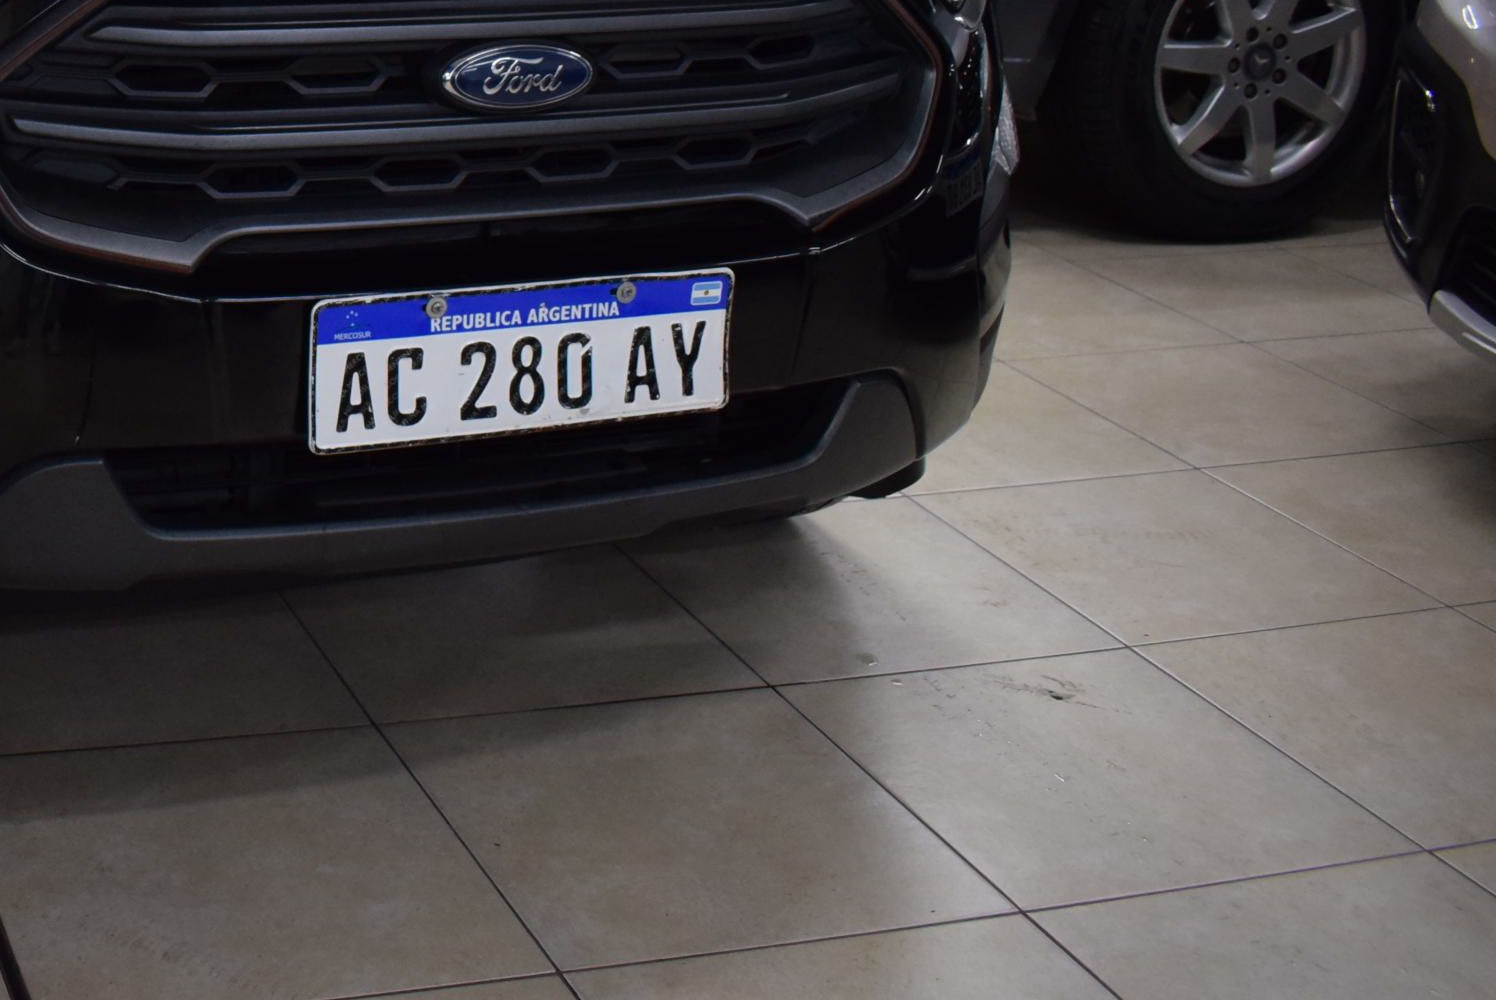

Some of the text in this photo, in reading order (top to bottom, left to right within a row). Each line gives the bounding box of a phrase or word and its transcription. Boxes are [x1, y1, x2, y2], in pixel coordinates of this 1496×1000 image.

[483, 57, 564, 95] Ford
[430, 301, 620, 333] REPUBLICA ARGENTINA
[333, 330, 372, 341] MERCOSUR
[336, 320, 708, 434] AC 280 AY
